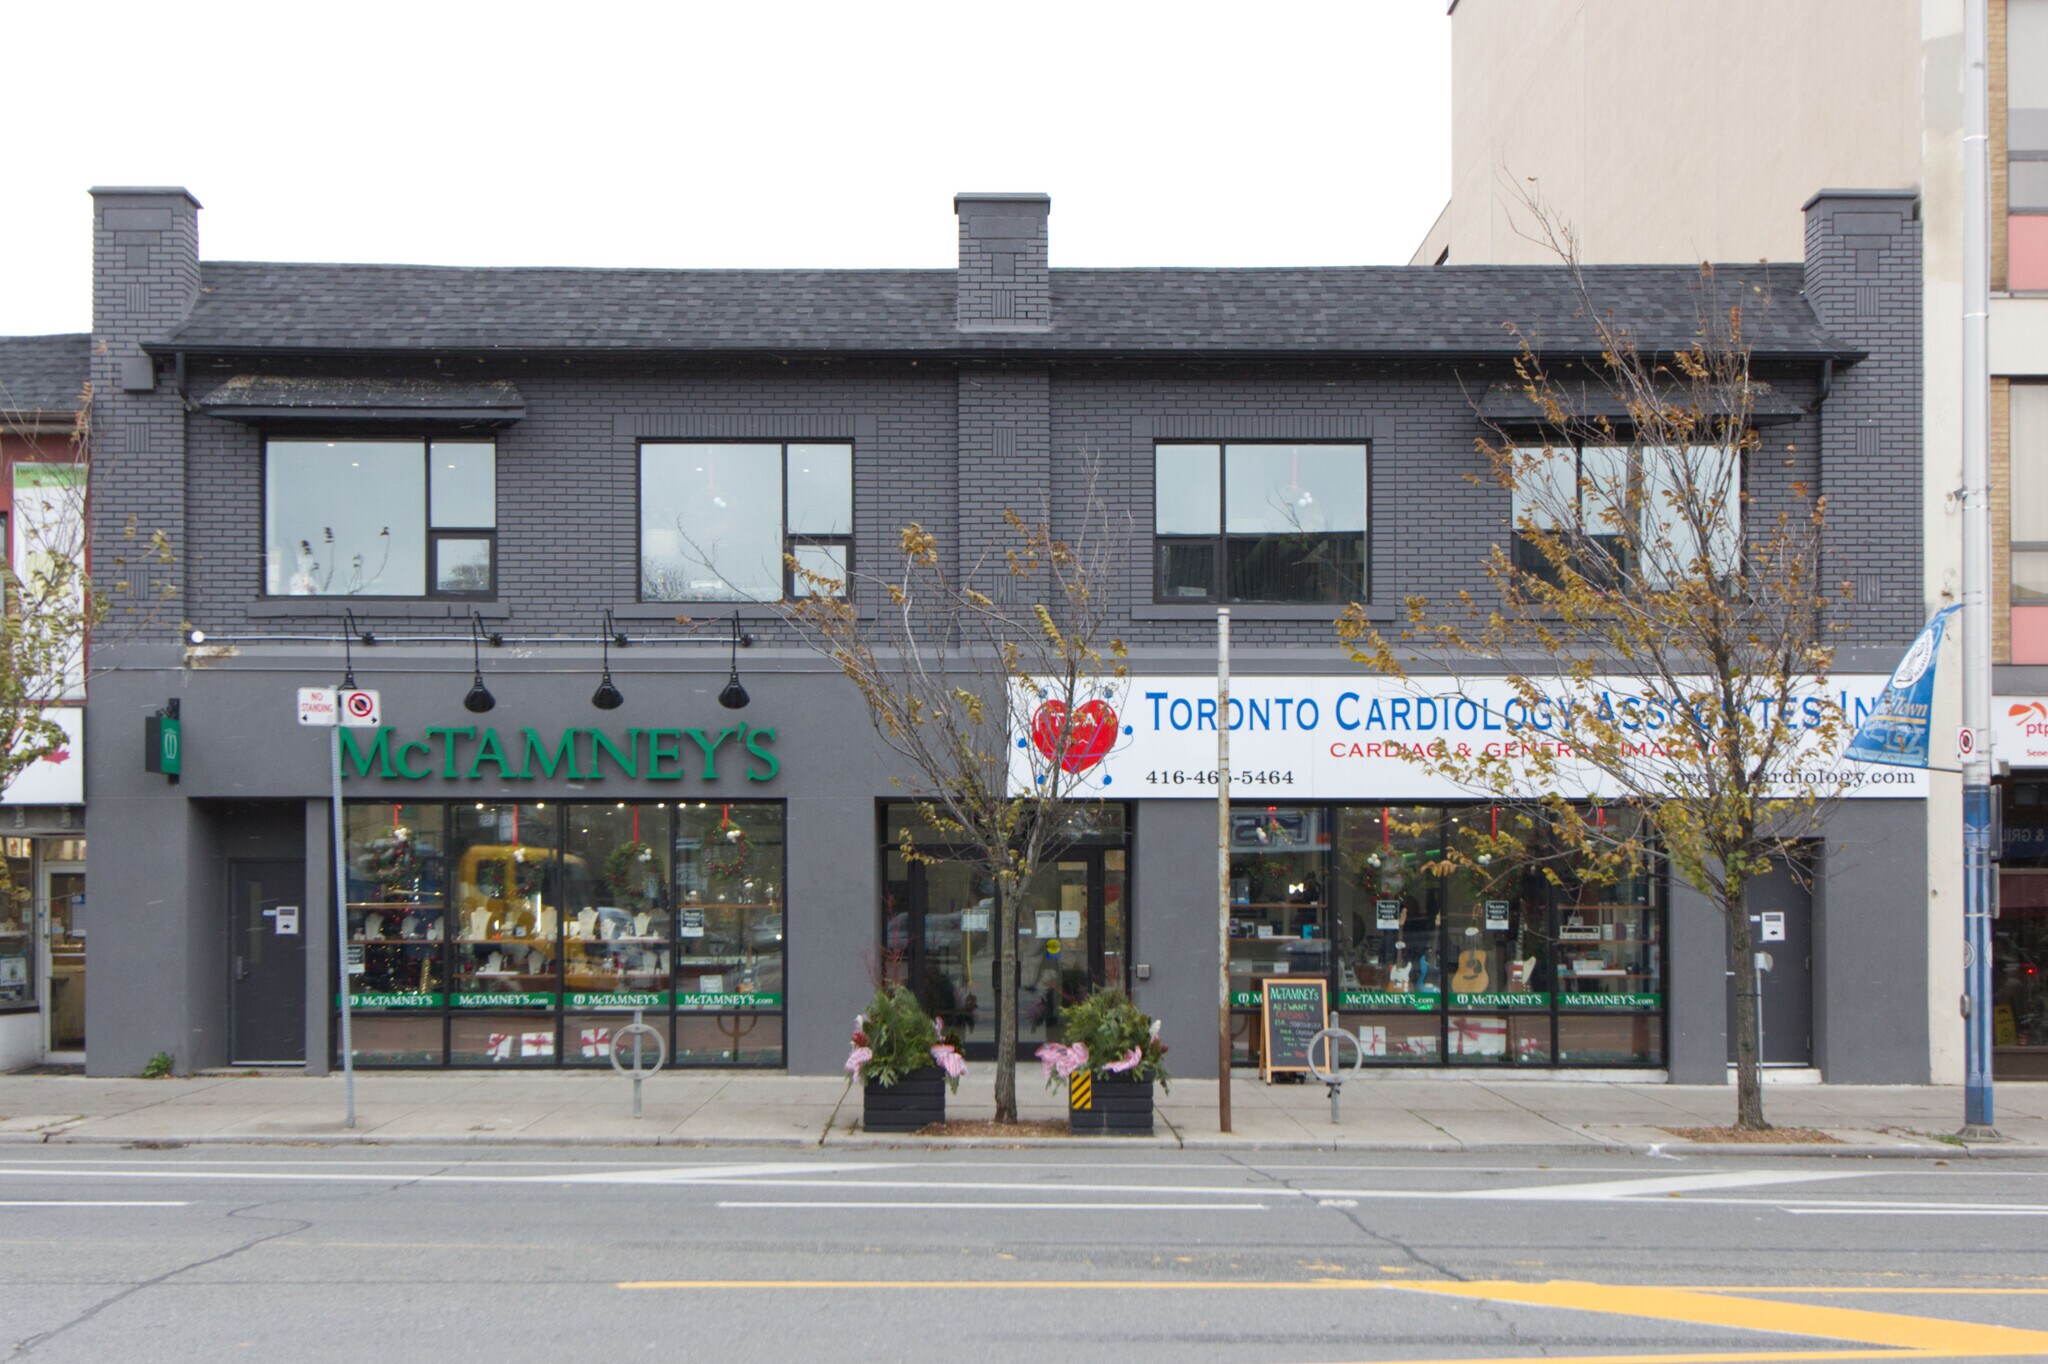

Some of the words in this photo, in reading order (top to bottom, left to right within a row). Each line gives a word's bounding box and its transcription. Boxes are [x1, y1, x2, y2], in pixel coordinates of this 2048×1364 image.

[311, 693, 323, 701] NO
[301, 703, 333, 712] STANDING
[1145, 691, 1320, 731] TORONTO
[1335, 691, 1577, 731] CARDIOLOGY
[339, 721, 780, 781] McTAMNEY'S
[1330, 742, 1440, 758] CARDIAC
[1456, 742, 1472, 757] &
[1485, 742, 1597, 758] GENR
[1146, 770, 1295, 785] 416-46-5464
[362, 995, 433, 1006] McTAMNEY'S
[588, 994, 659, 1005] McTAMNEY'S
[1471, 994, 1542, 1005] McTAMNEY'S
